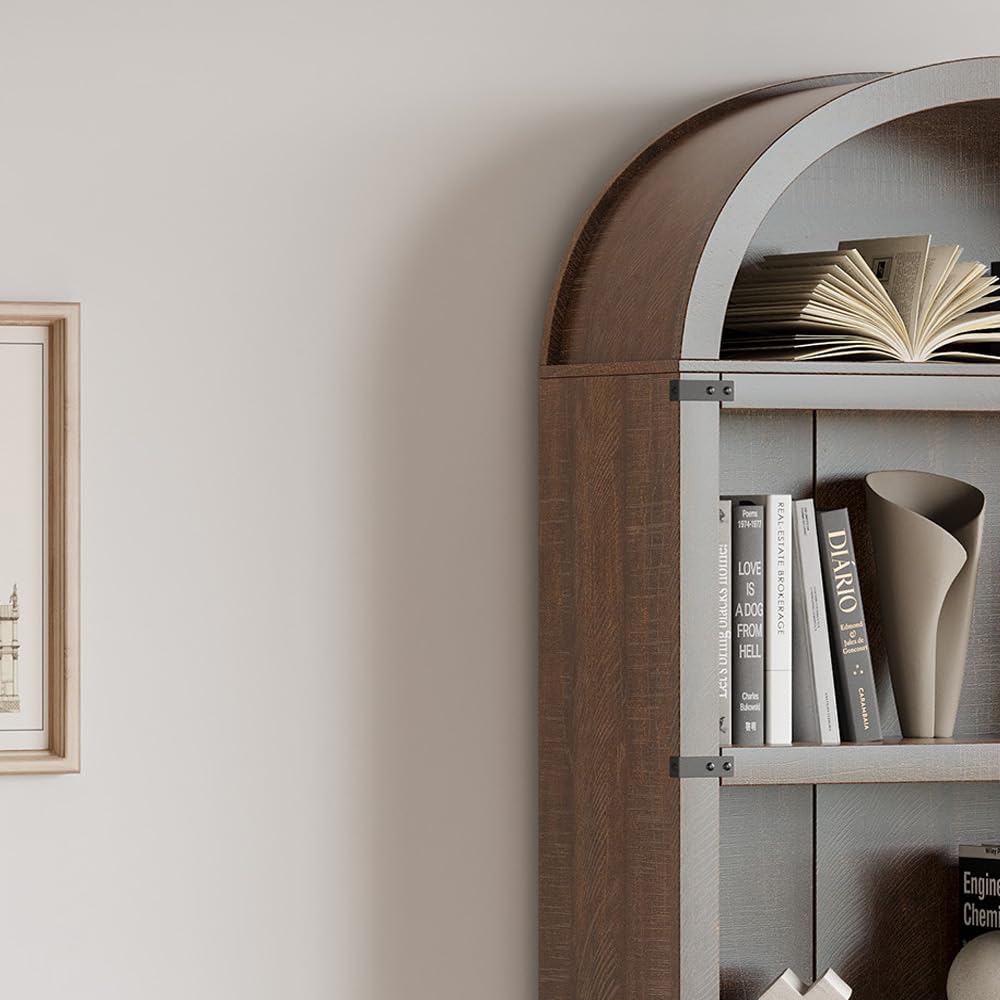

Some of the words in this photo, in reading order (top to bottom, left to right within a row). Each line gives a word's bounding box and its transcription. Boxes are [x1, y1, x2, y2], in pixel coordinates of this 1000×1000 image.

[742, 509, 758, 518] Poems
[777, 502, 785, 568] REAL-ESTATE
[738, 561, 762, 576] LOVE
[828, 529, 858, 613] DIÁRIO
[746, 581, 755, 596] IS
[734, 602, 744, 617] A
[744, 602, 764, 617] DOG
[777, 570, 785, 635] BROKERAGE
[737, 623, 763, 638] FROM
[739, 644, 762, 659] HELL
